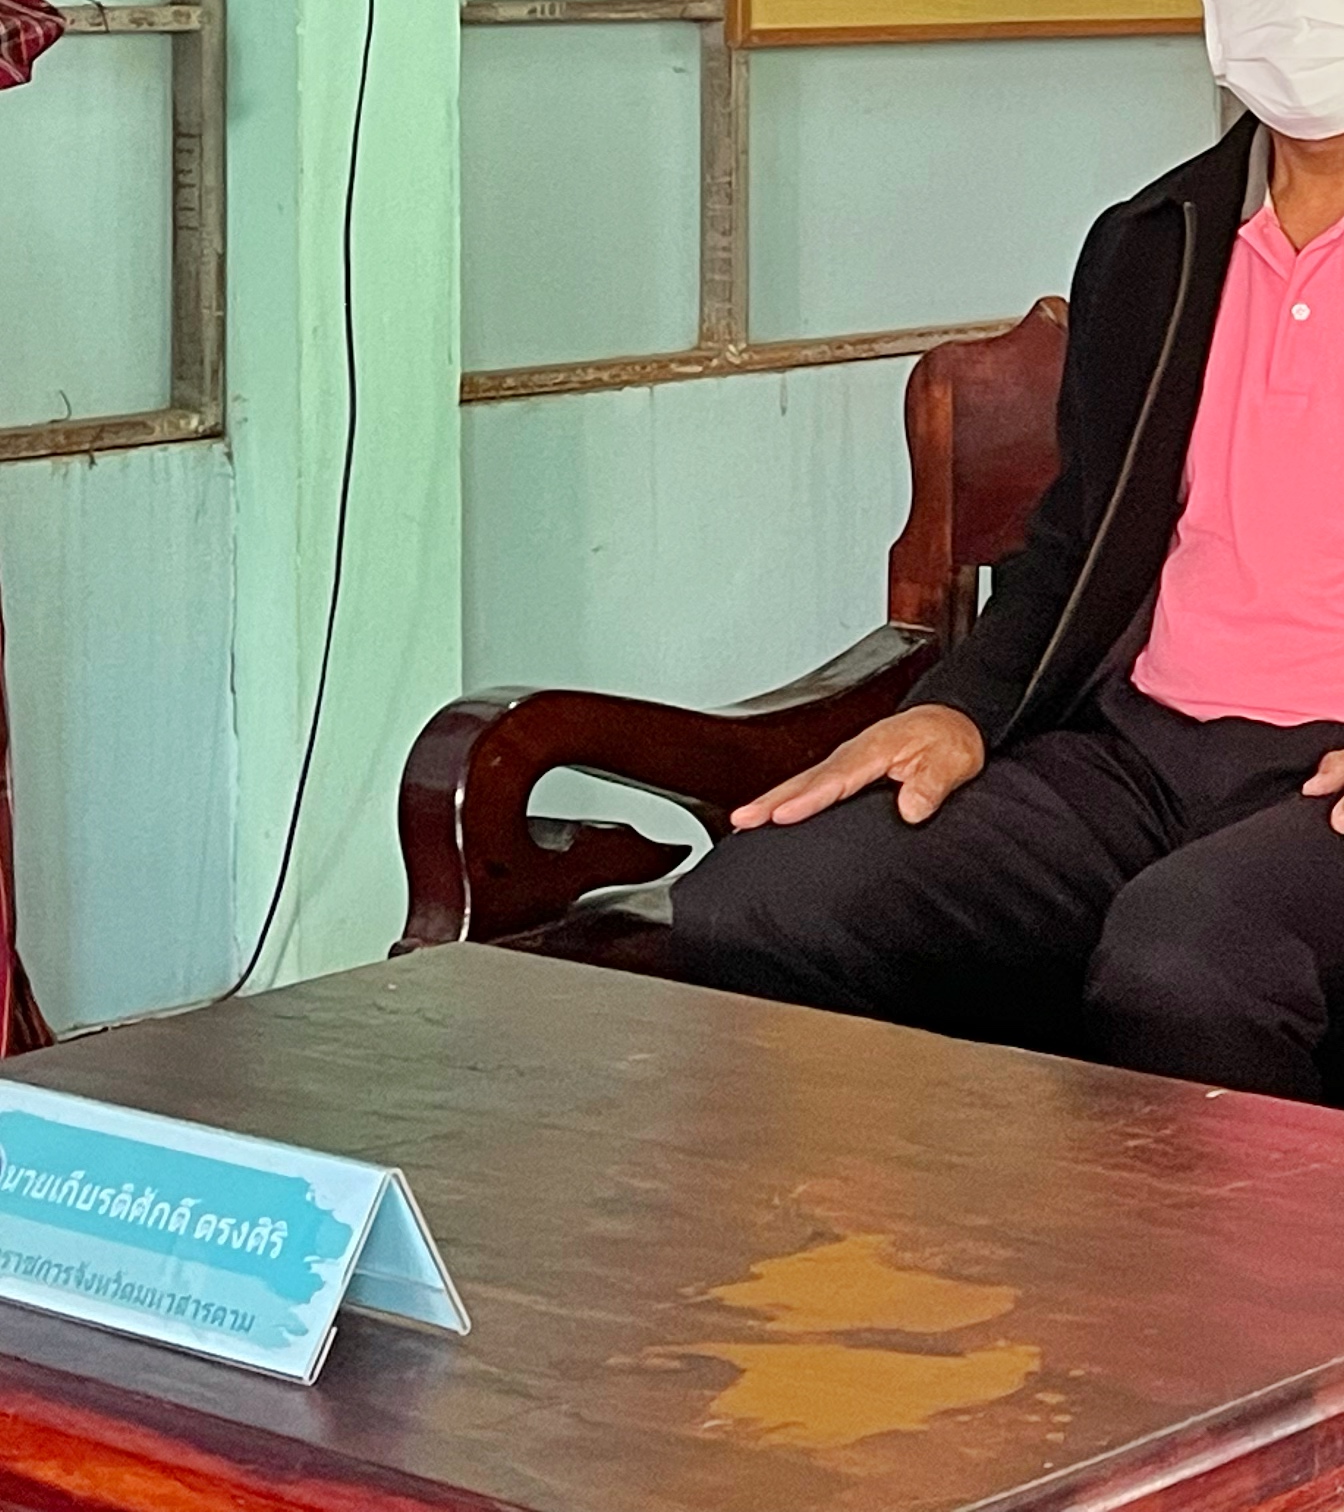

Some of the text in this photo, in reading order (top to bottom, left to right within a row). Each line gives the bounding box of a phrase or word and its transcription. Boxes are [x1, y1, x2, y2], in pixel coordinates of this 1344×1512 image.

[193, 1213, 289, 1259] ตรงศิริ
[0, 1248, 256, 1333] ราชการจังหวัดมหาสารคาม
